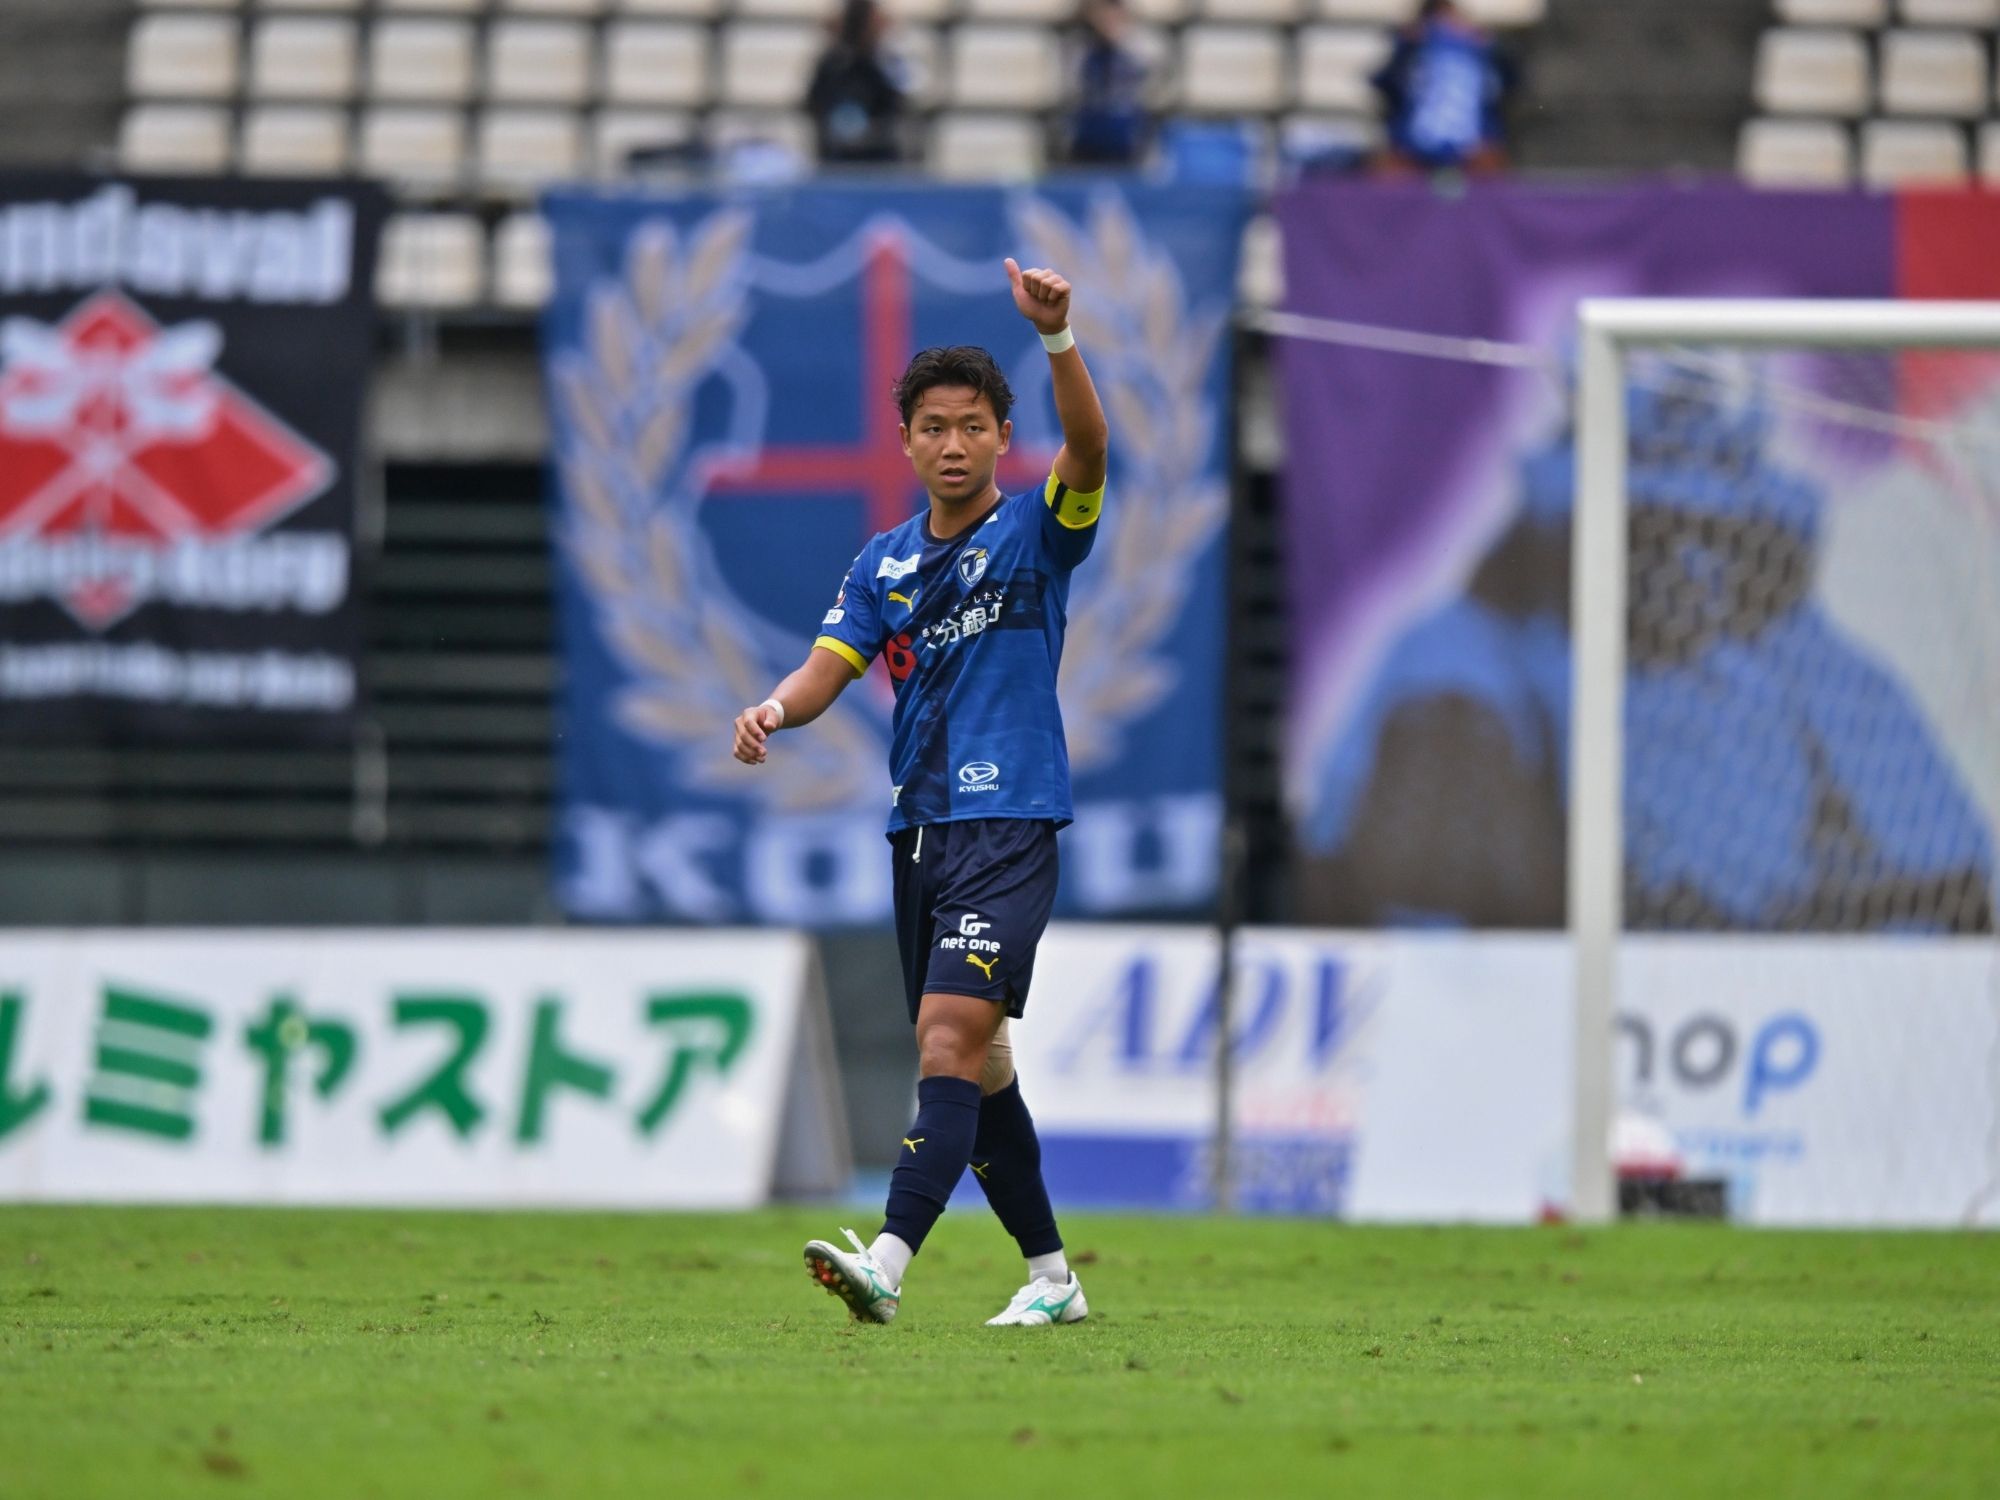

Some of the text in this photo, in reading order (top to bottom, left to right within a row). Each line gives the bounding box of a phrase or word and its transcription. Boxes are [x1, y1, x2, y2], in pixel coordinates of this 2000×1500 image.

[926, 602, 1003, 649] 分銀
[959, 783, 999, 793] KYUSHU
[562, 797, 1220, 925] KOU
[940, 936, 1001, 953] net one
